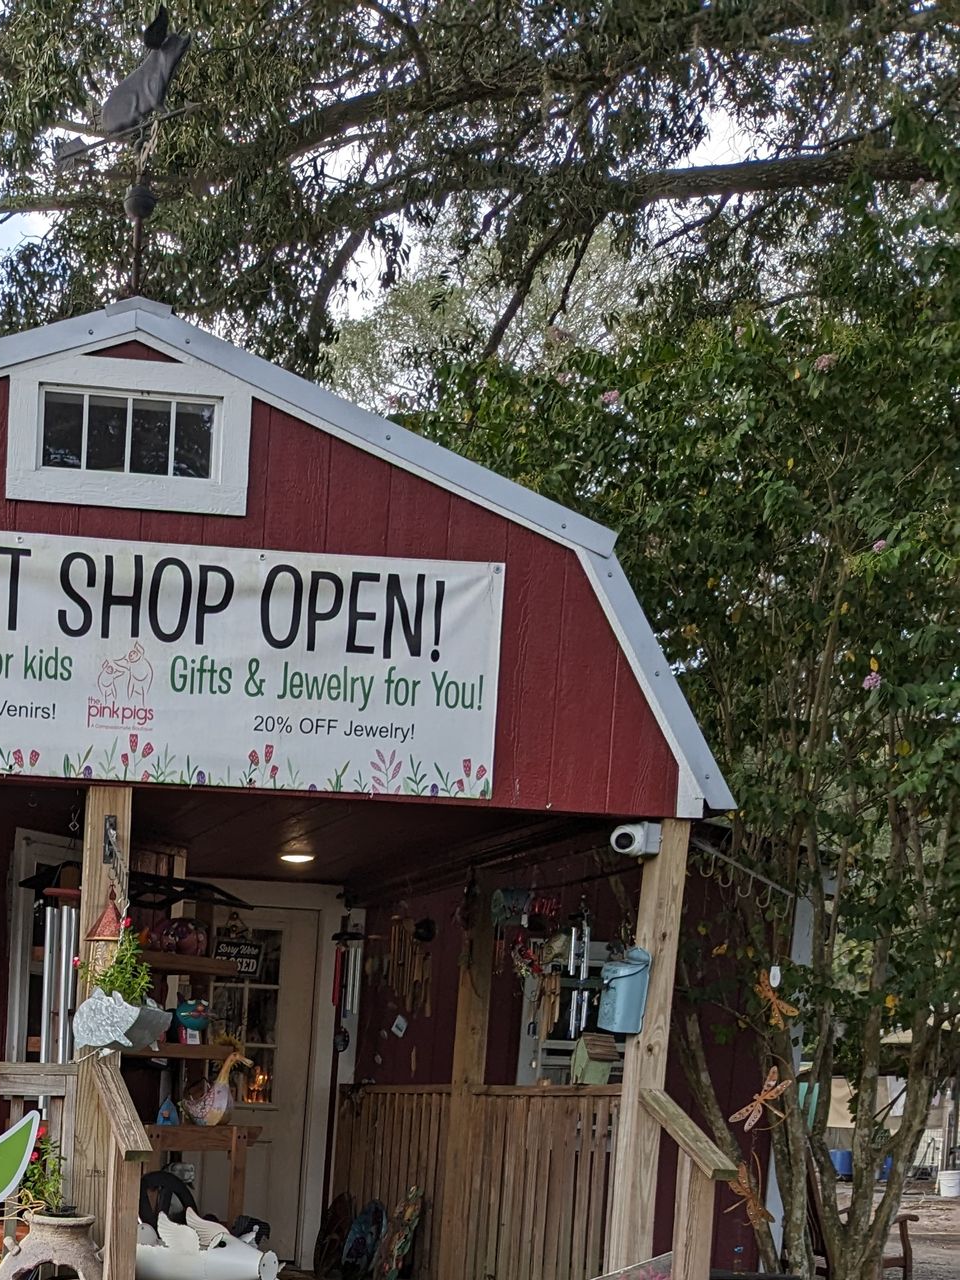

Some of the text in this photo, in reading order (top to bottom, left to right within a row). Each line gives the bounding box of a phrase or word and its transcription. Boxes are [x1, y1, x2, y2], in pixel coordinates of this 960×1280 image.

[57, 551, 235, 645] SHOP
[260, 563, 446, 663] OPEN!
[23, 645, 73, 682] kids
[170, 655, 484, 712] Gifts & Jewelry for You!
[87, 696, 101, 705] the
[87, 701, 154, 728] pink pigs
[253, 715, 415, 743] 20% OFF Jewelry!
